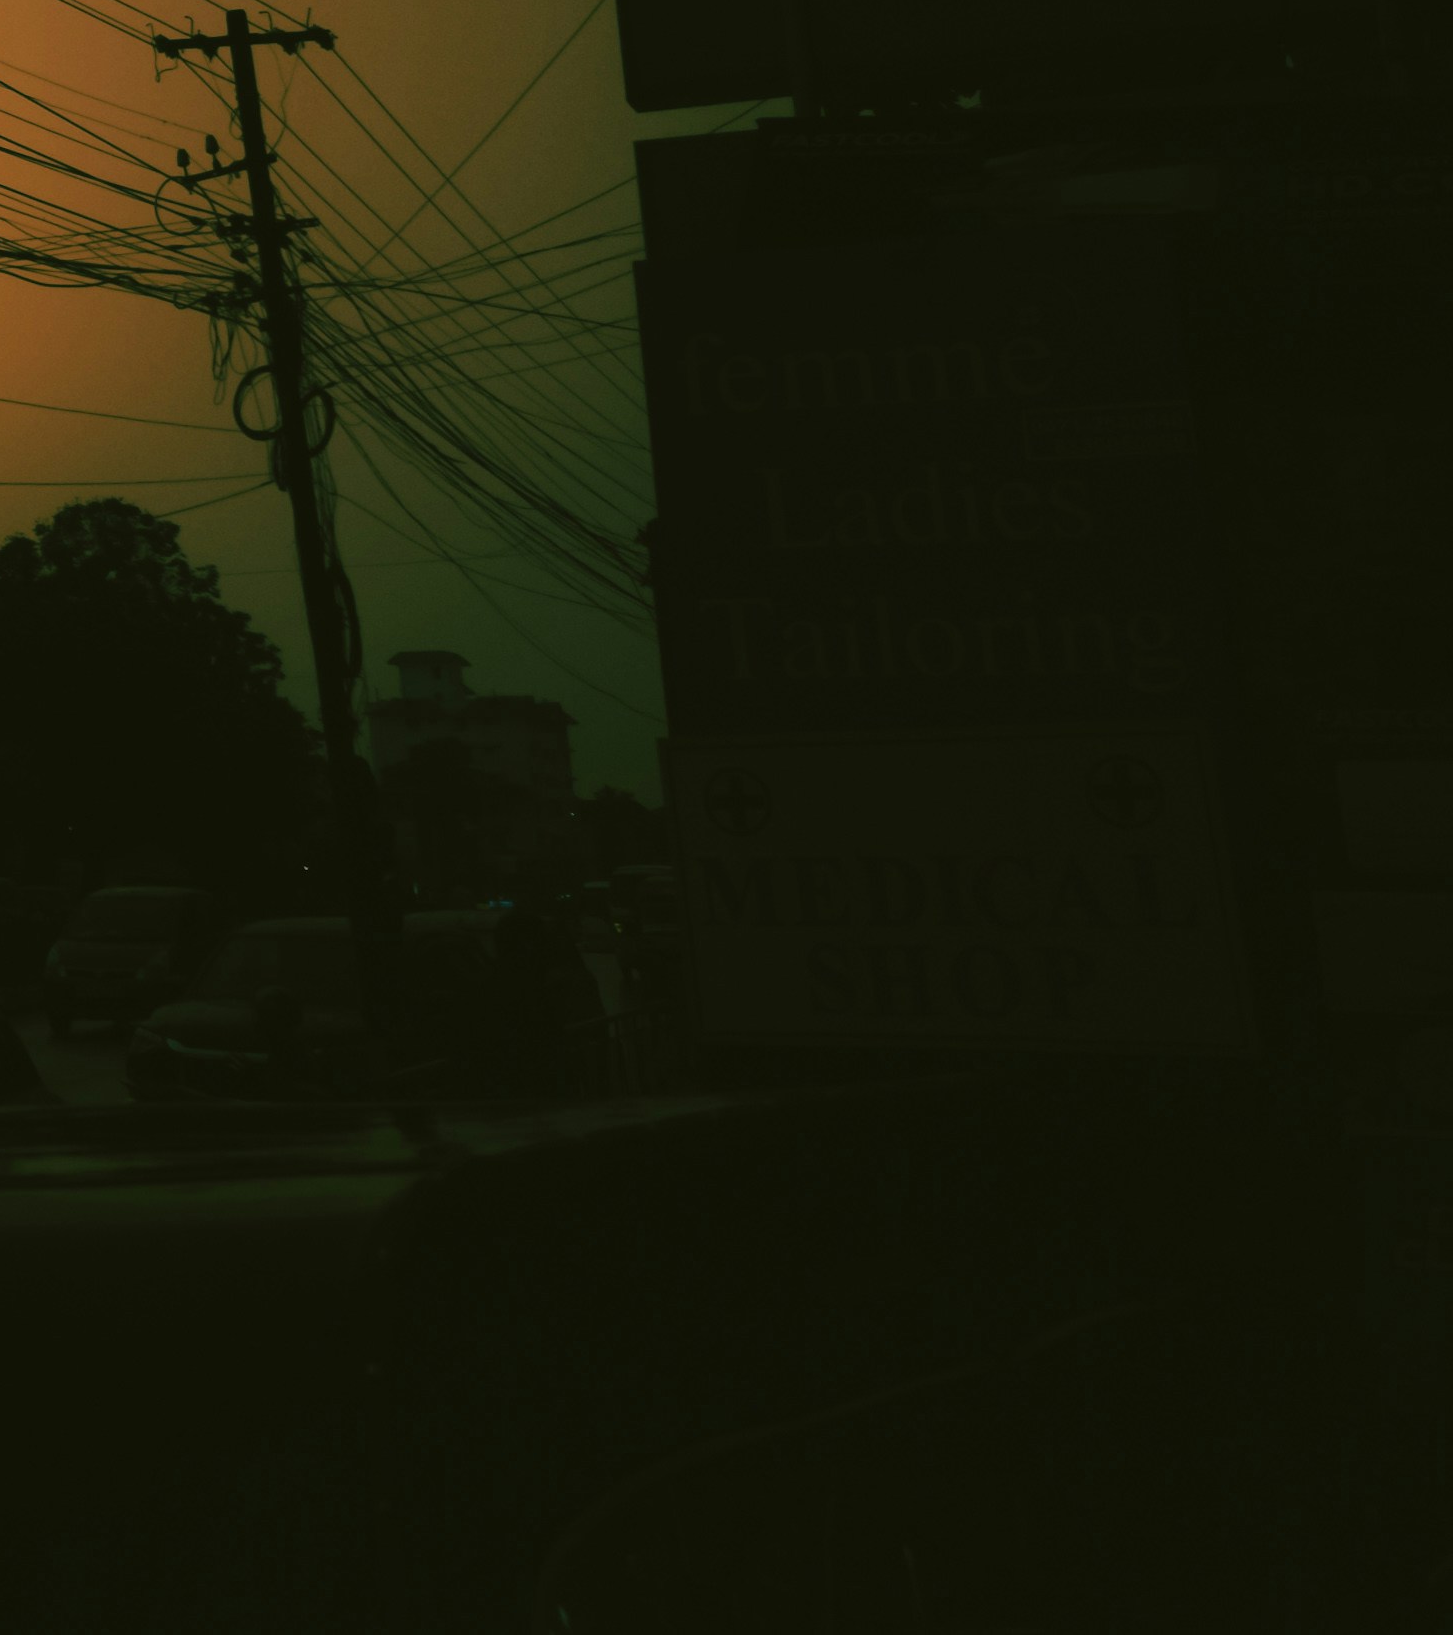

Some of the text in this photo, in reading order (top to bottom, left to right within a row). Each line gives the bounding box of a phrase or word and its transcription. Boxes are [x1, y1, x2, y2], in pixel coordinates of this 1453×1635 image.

[755, 461, 1095, 549] Ladies
[699, 590, 1187, 694] Tailoring
[694, 851, 1199, 930] MEDICAL
[805, 942, 1096, 1021] SHOP
